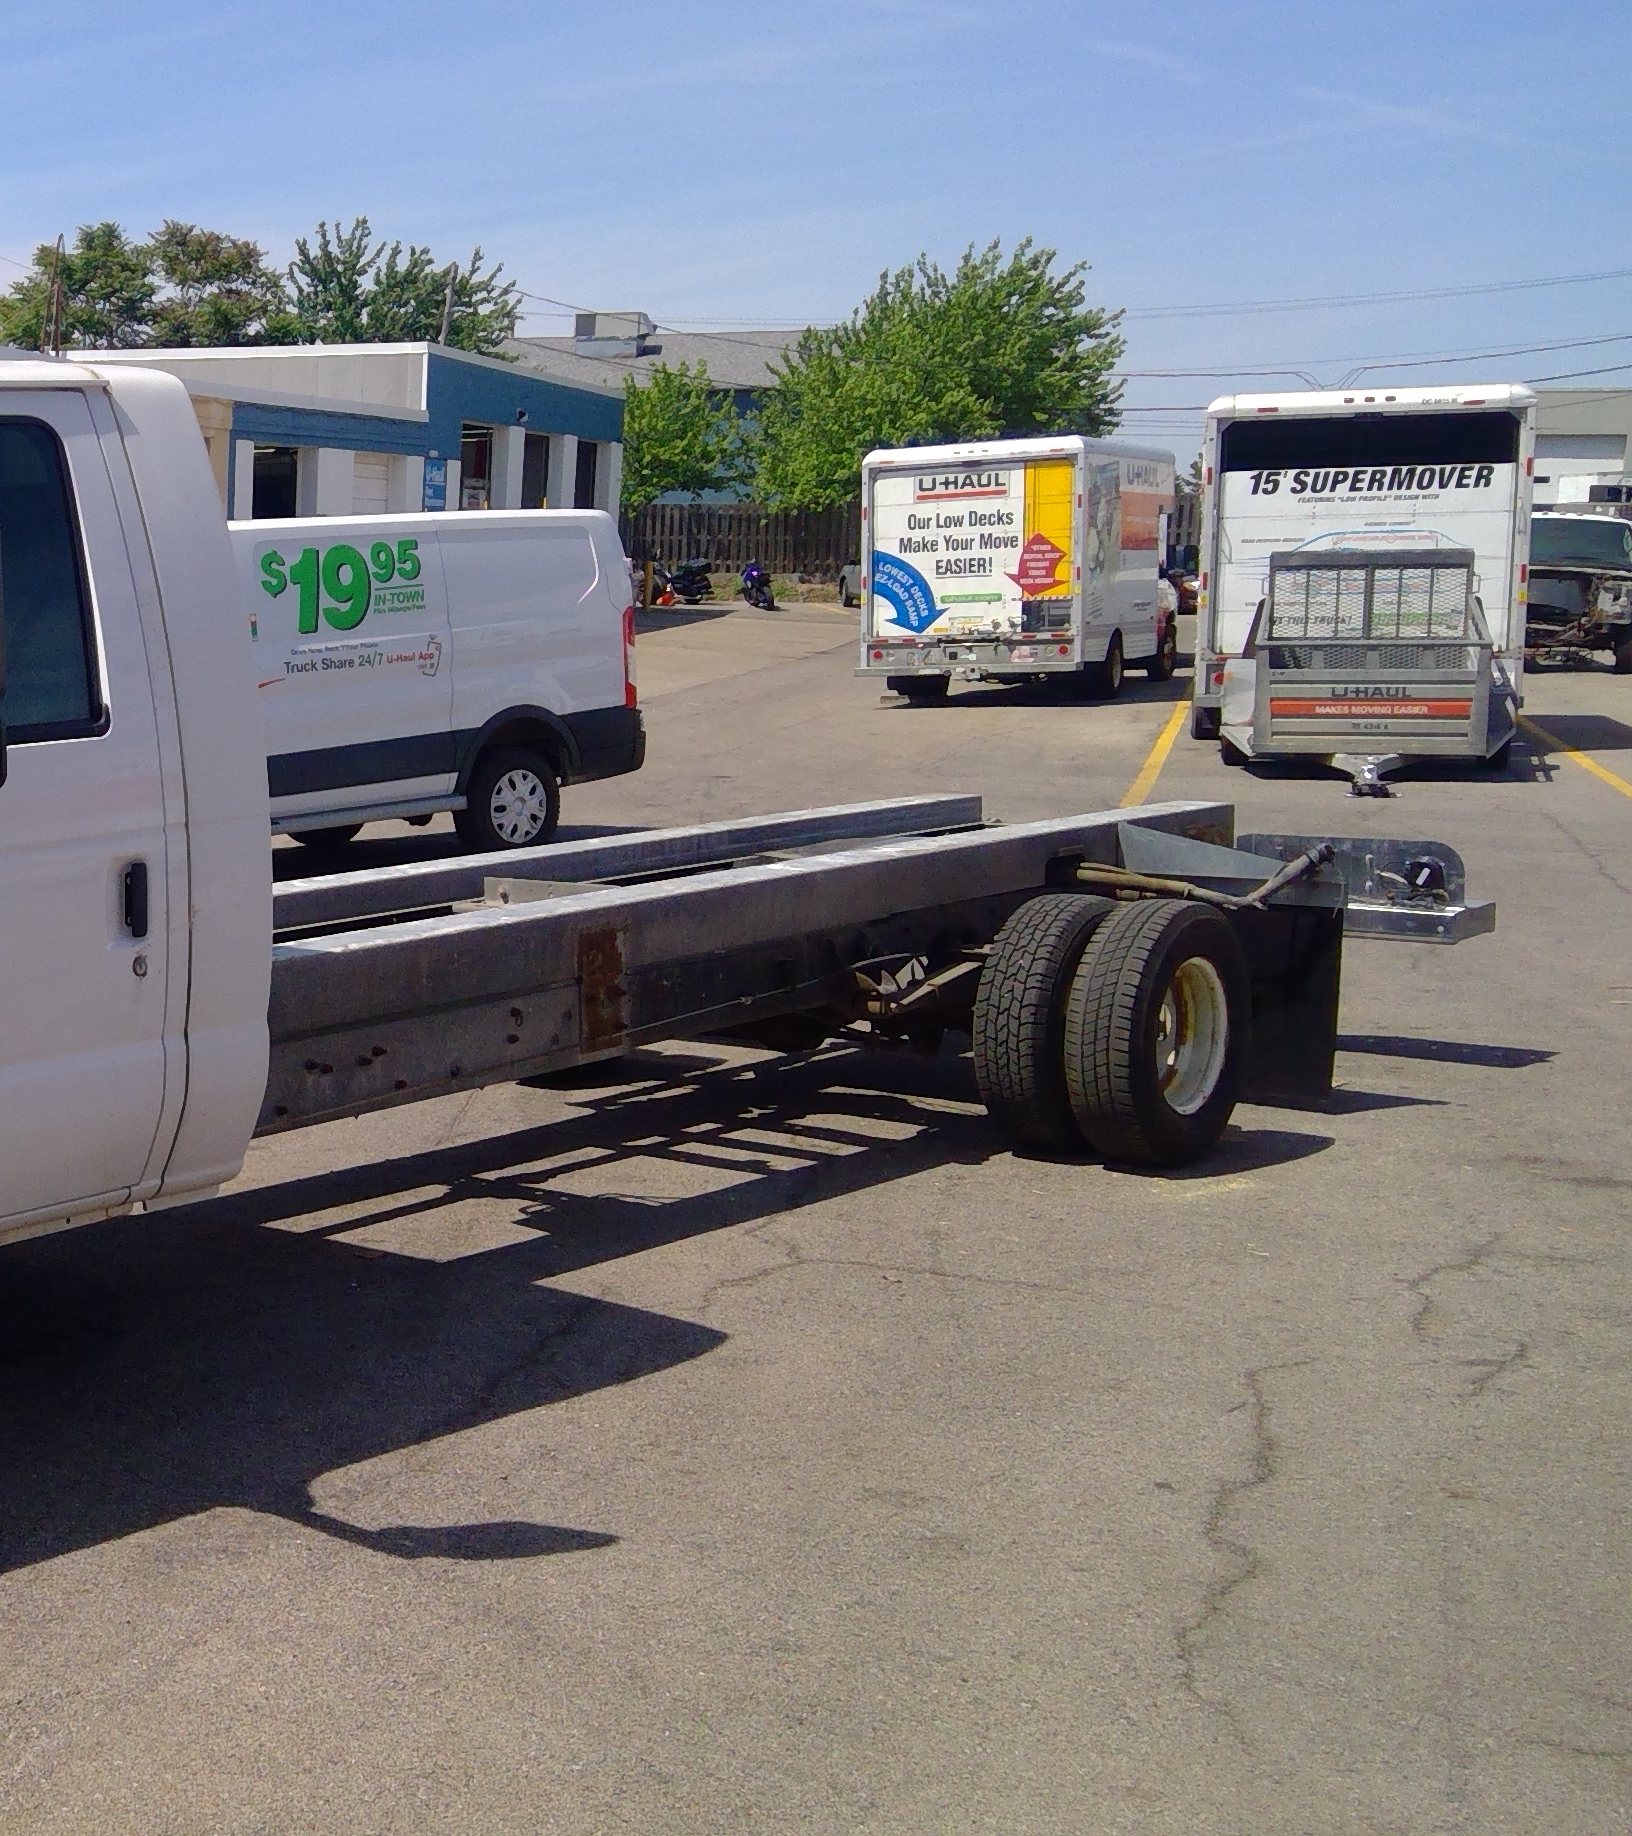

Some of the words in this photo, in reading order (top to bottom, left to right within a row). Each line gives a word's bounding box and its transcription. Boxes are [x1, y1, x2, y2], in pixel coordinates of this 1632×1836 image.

[918, 472, 1007, 492] U-HAUL
[1289, 465, 1495, 495] SUPERMOVER
[908, 514, 933, 531] Our
[936, 512, 965, 529] Low
[968, 509, 1014, 527] Decks
[899, 536, 939, 554] Make
[943, 534, 975, 552] Your
[979, 532, 1019, 550] Move
[935, 556, 993, 577] EASIER!
[374, 589, 425, 607] IN-TOWN
[284, 661, 318, 674] Truck
[321, 655, 355, 671] Share
[358, 651, 384, 668] 24/7
[387, 652, 416, 664] U-Haul
[418, 651, 435, 662] App
[1315, 706, 1349, 714] MAKES
[1351, 706, 1392, 714] MOVING
[1393, 705, 1429, 714] EASIER
